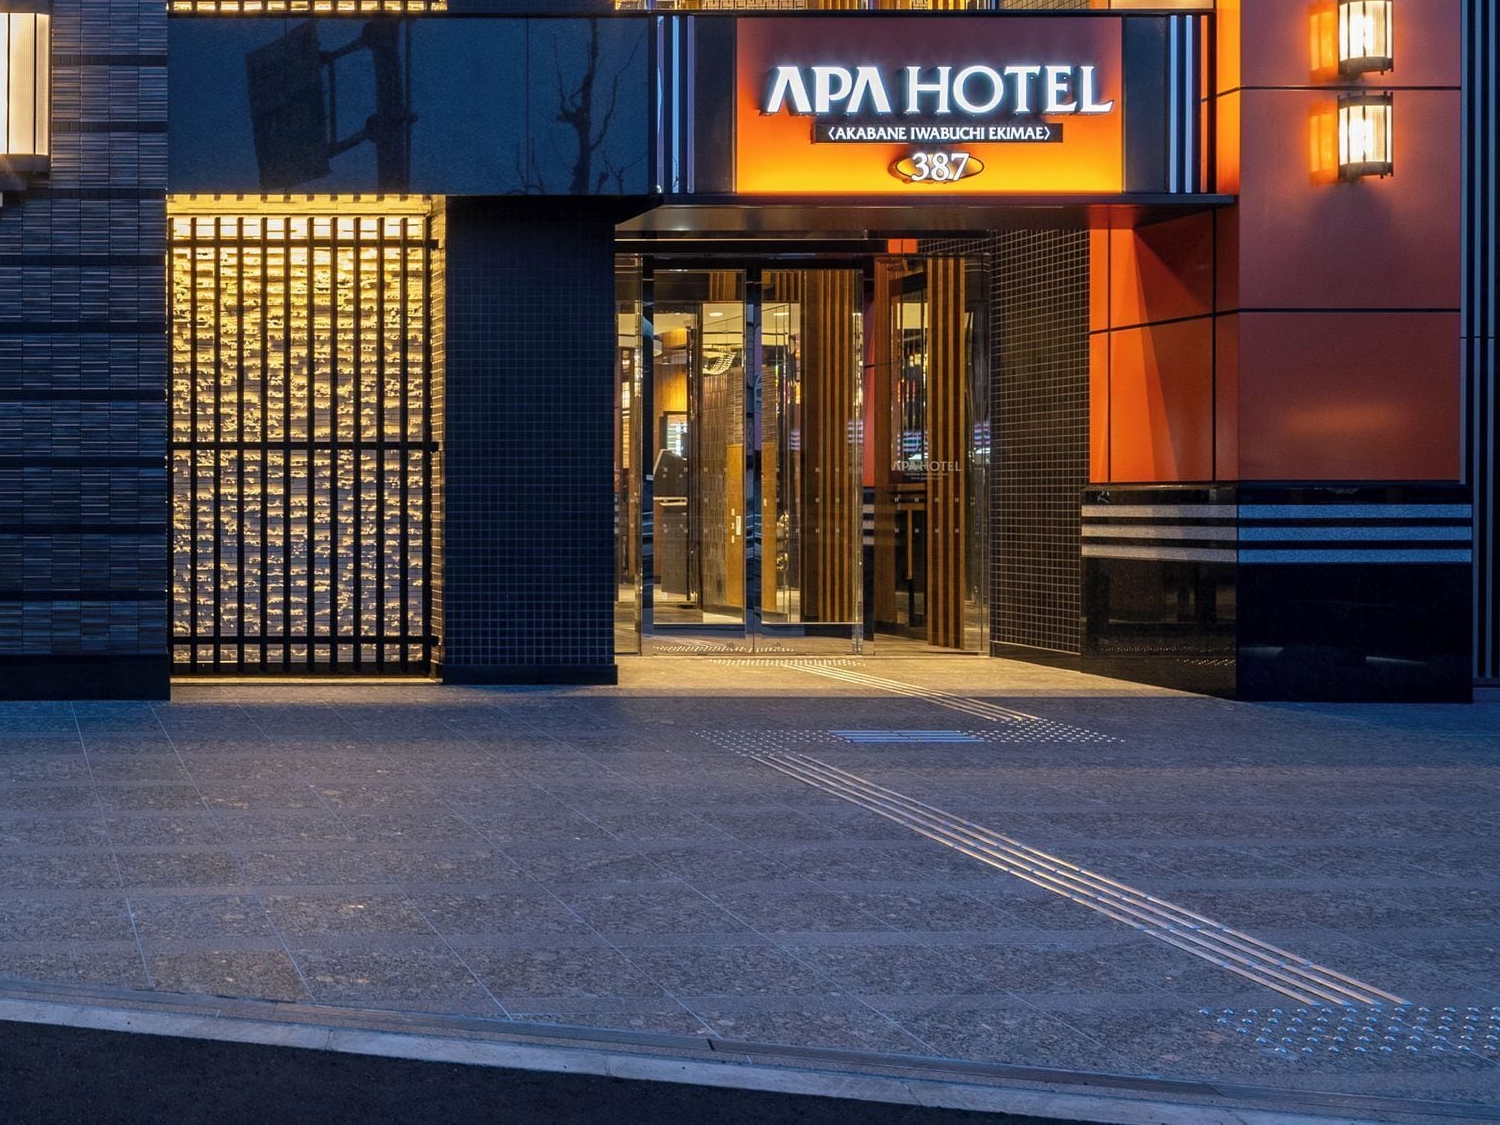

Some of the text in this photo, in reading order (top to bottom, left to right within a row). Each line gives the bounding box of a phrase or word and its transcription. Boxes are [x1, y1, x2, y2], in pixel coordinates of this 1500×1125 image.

[766, 65, 1115, 114] APA HOTEL
[910, 126, 986, 142] IWABUCHI
[911, 152, 970, 182] 387
[918, 461, 961, 471] HOTEL
